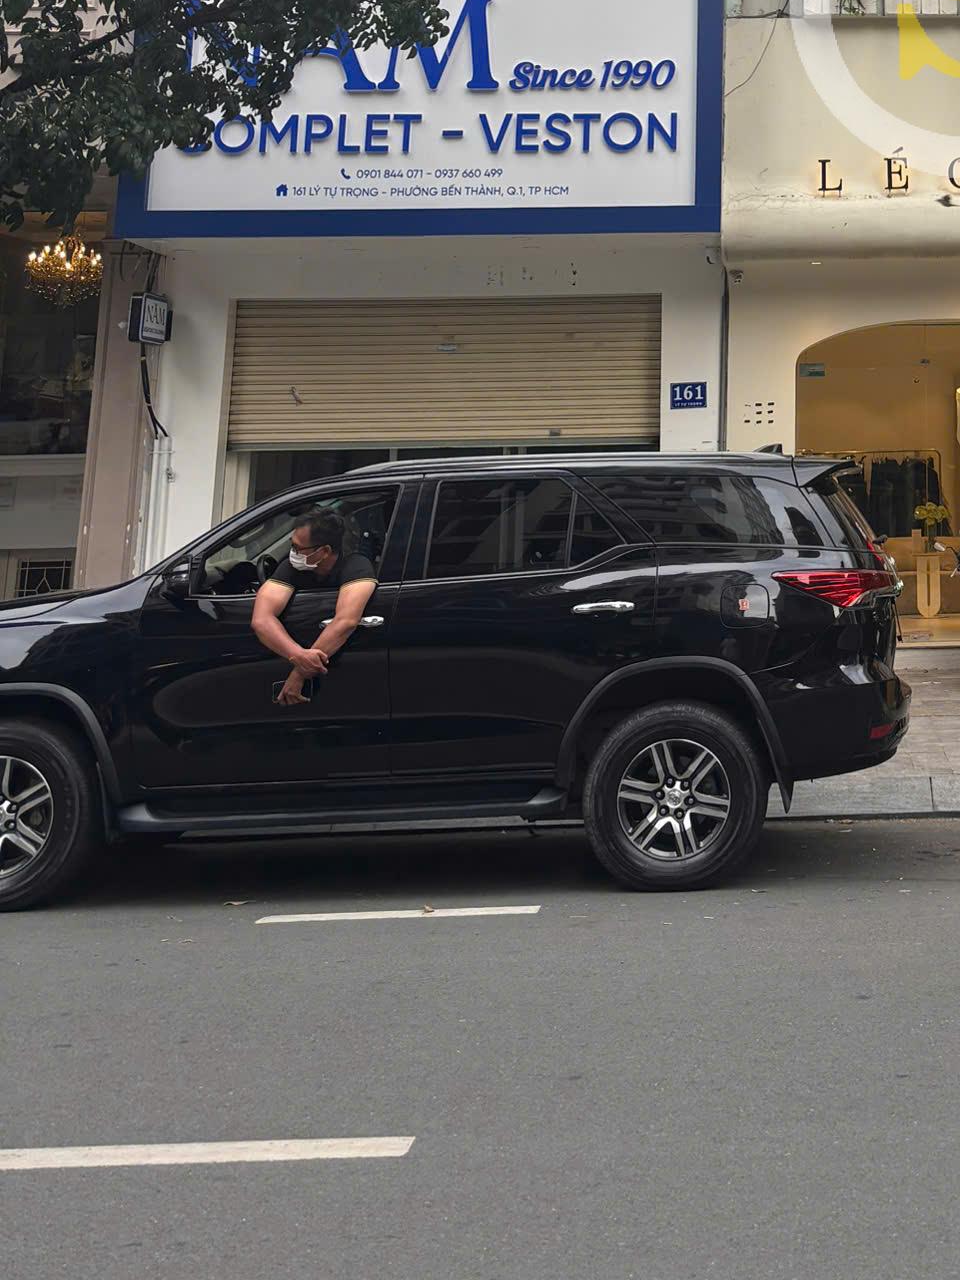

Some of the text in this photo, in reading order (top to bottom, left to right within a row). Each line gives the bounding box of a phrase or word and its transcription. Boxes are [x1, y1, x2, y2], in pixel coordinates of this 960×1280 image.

[509, 59, 676, 90] Since 1990
[179, 113, 422, 154] OMPLET
[479, 112, 678, 154] VESTON
[356, 168, 381, 179] 0901
[384, 168, 404, 179] 844
[406, 168, 424, 179] 071
[434, 168, 459, 179] 0937
[462, 168, 482, 178] 660
[484, 168, 503, 178] 499
[293, 186, 306, 196] 161
[309, 184, 321, 196] LÝ
[340, 187, 379, 199] TRỌNG
[529, 186, 541, 195] TP
[544, 186, 569, 195] HCM
[673, 385, 705, 401] 161
